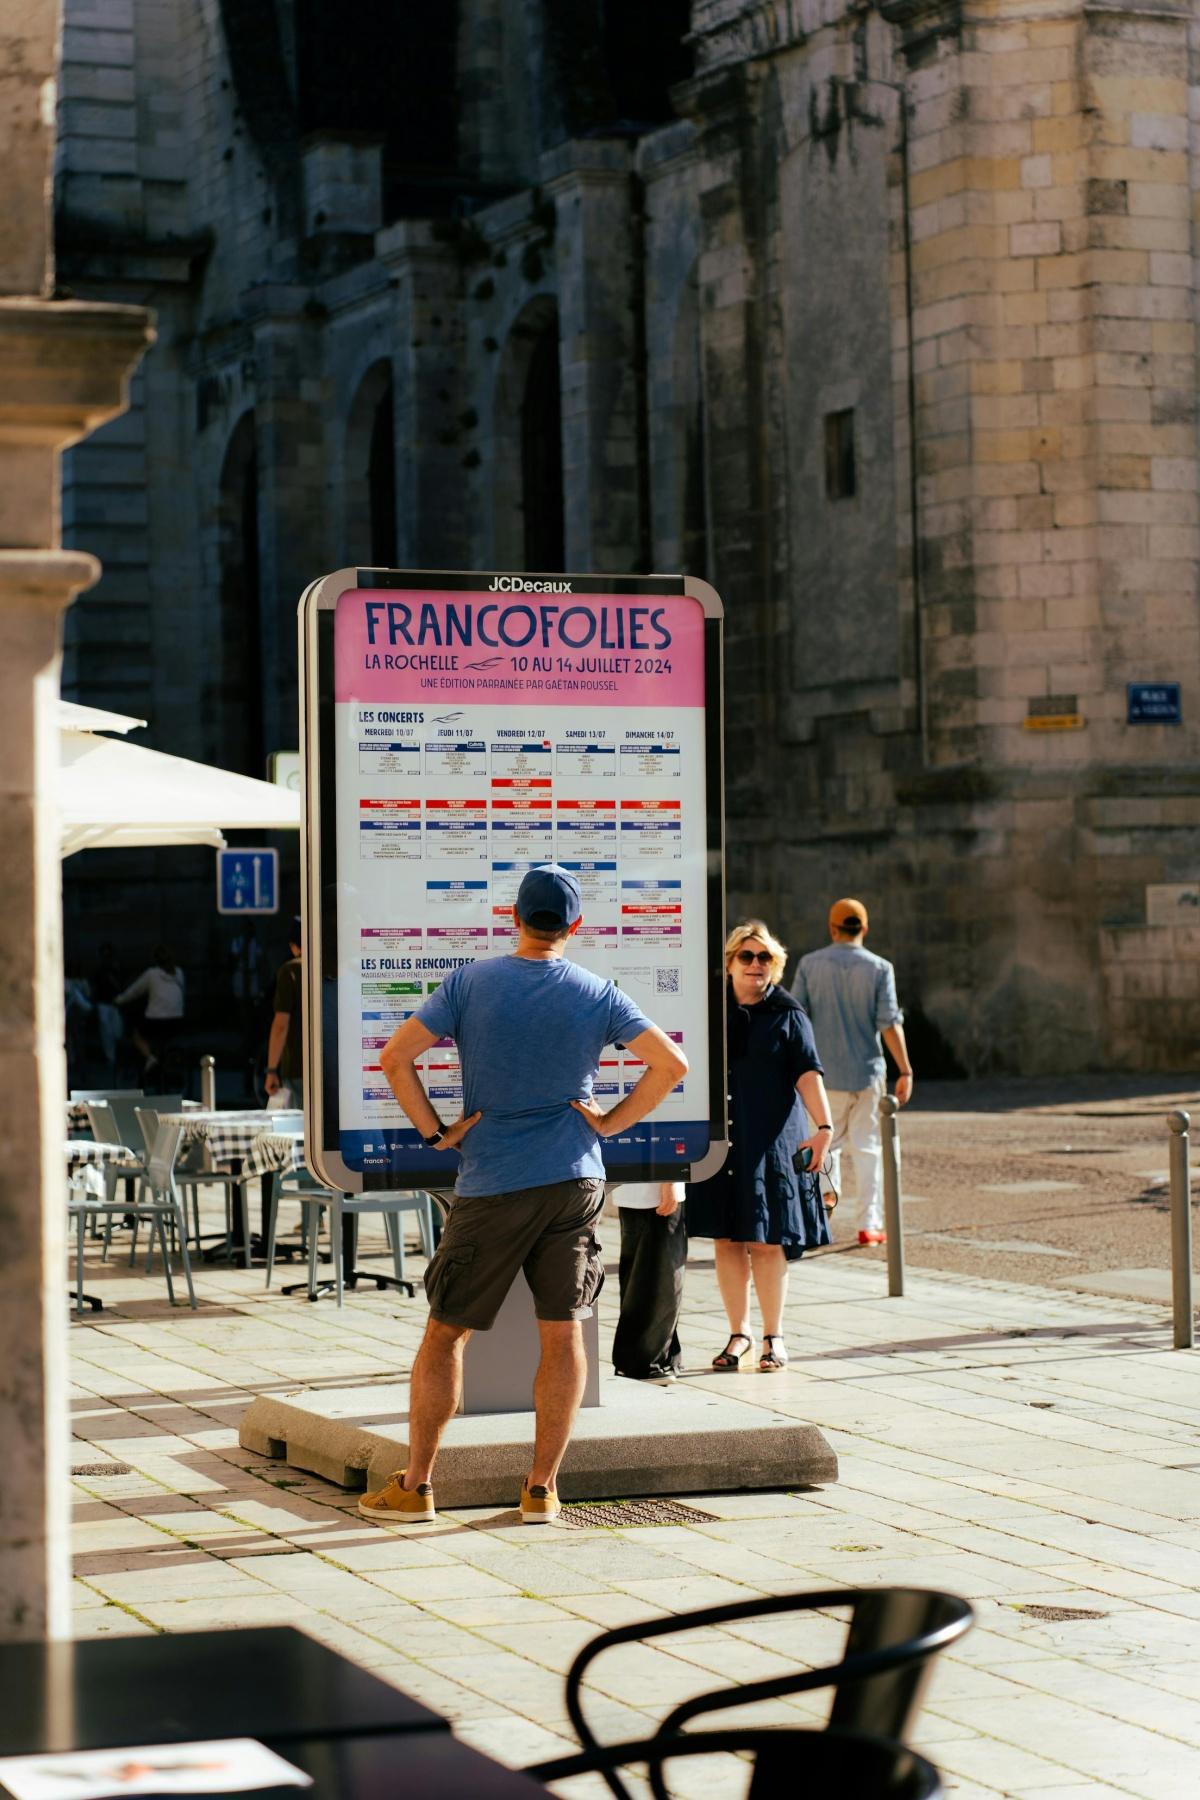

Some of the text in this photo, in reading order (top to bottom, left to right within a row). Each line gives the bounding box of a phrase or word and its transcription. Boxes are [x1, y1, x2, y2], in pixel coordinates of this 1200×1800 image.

[489, 577, 572, 593] JCDecaux
[365, 602, 672, 650] FRANCOFOLIES
[365, 654, 672, 674] LA ROCHELLE 10 AU 14 JUILLET 2024
[420, 679, 438, 689] UNE
[440, 676, 475, 689] ÉDITION
[477, 677, 524, 690] PARRAINÉE
[526, 680, 544, 690] PAR
[581, 680, 619, 691] ROUSSEL
[359, 711, 425, 724] LES CONCERTS
[364, 728, 414, 737] MERCREDI 10/07
[437, 729, 474, 737] JEUDI 11/07
[496, 729, 546, 738] VENDREDI 12/07
[565, 730, 606, 739] SAMEDI 13/07
[625, 731, 675, 739] DIMANCHE 14/07
[361, 958, 377, 970] LES
[379, 957, 412, 970] FOLLES
